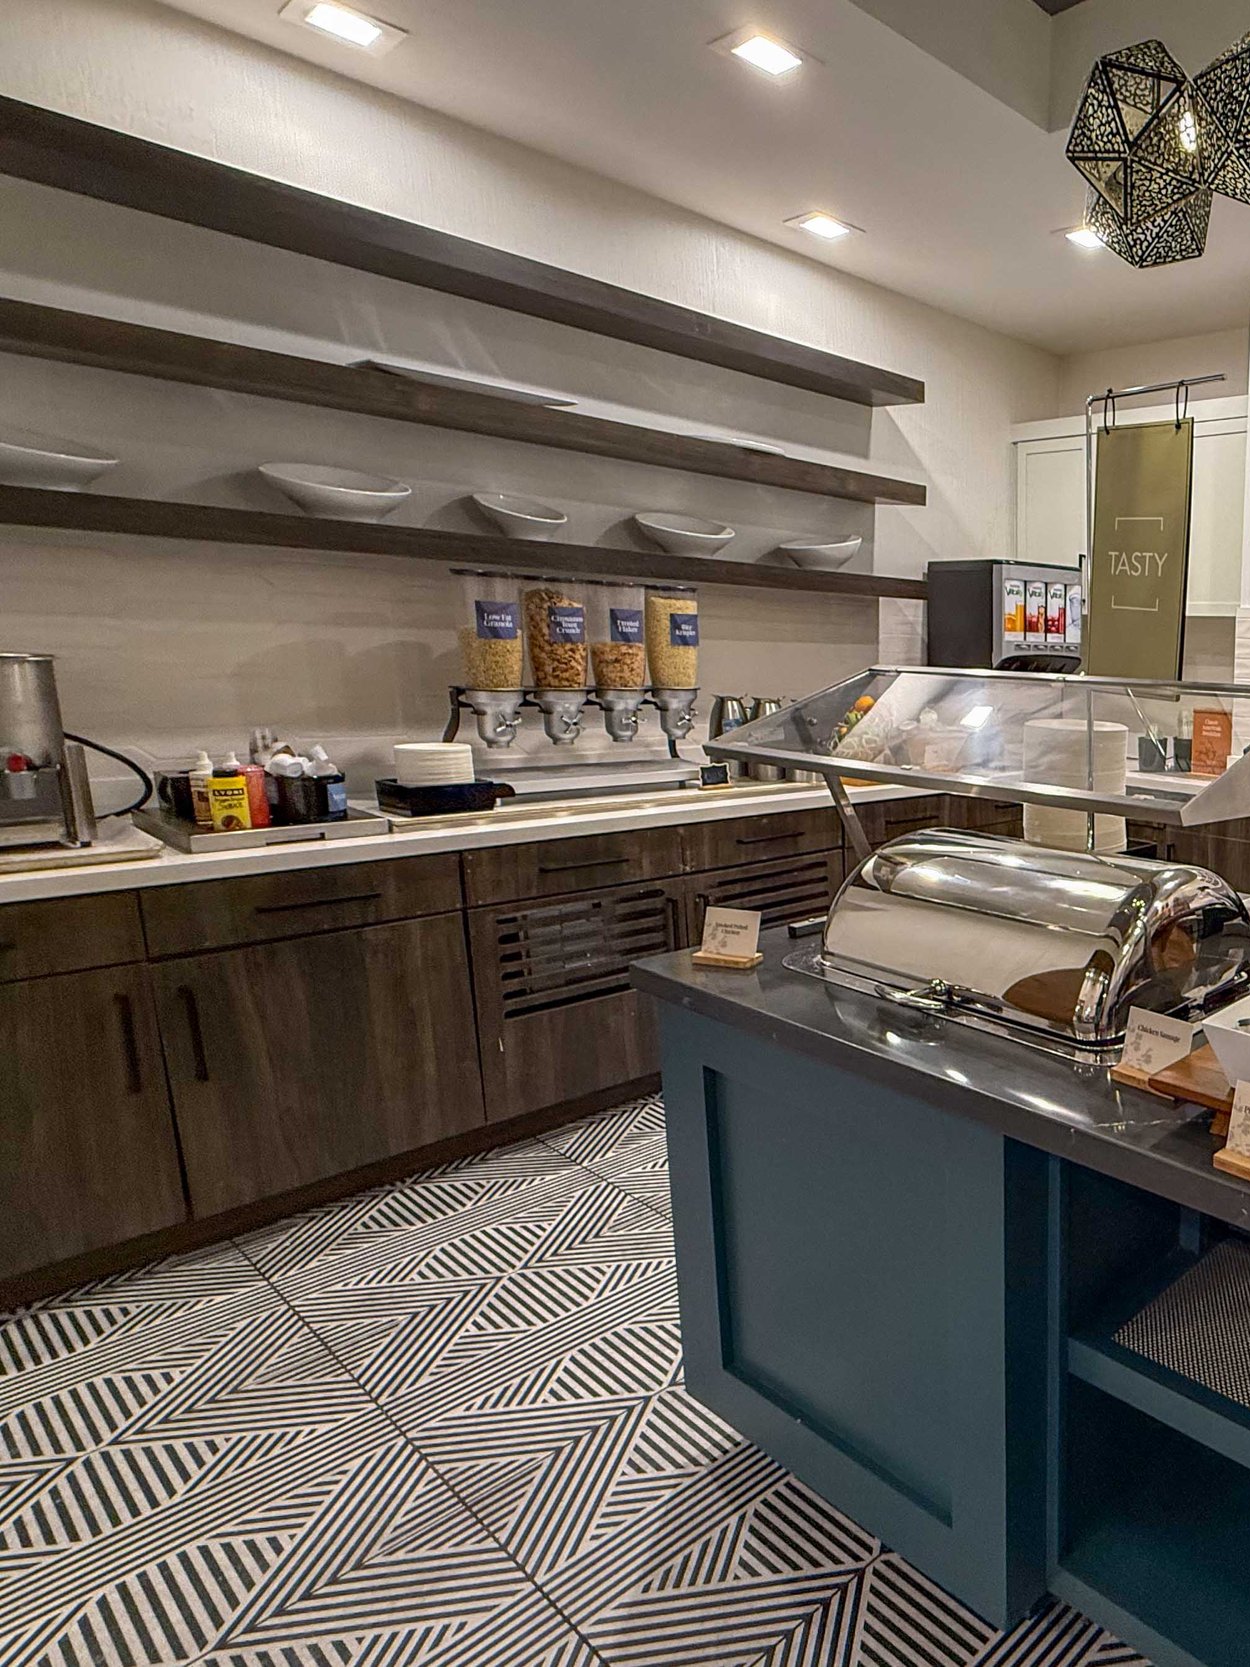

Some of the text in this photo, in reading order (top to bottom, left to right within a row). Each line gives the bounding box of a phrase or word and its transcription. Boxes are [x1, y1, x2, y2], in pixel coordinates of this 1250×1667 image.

[1108, 551, 1168, 577] TASTY
[483, 619, 513, 629] Granola
[1137, 1024, 1181, 1044] Chicken Sausage
